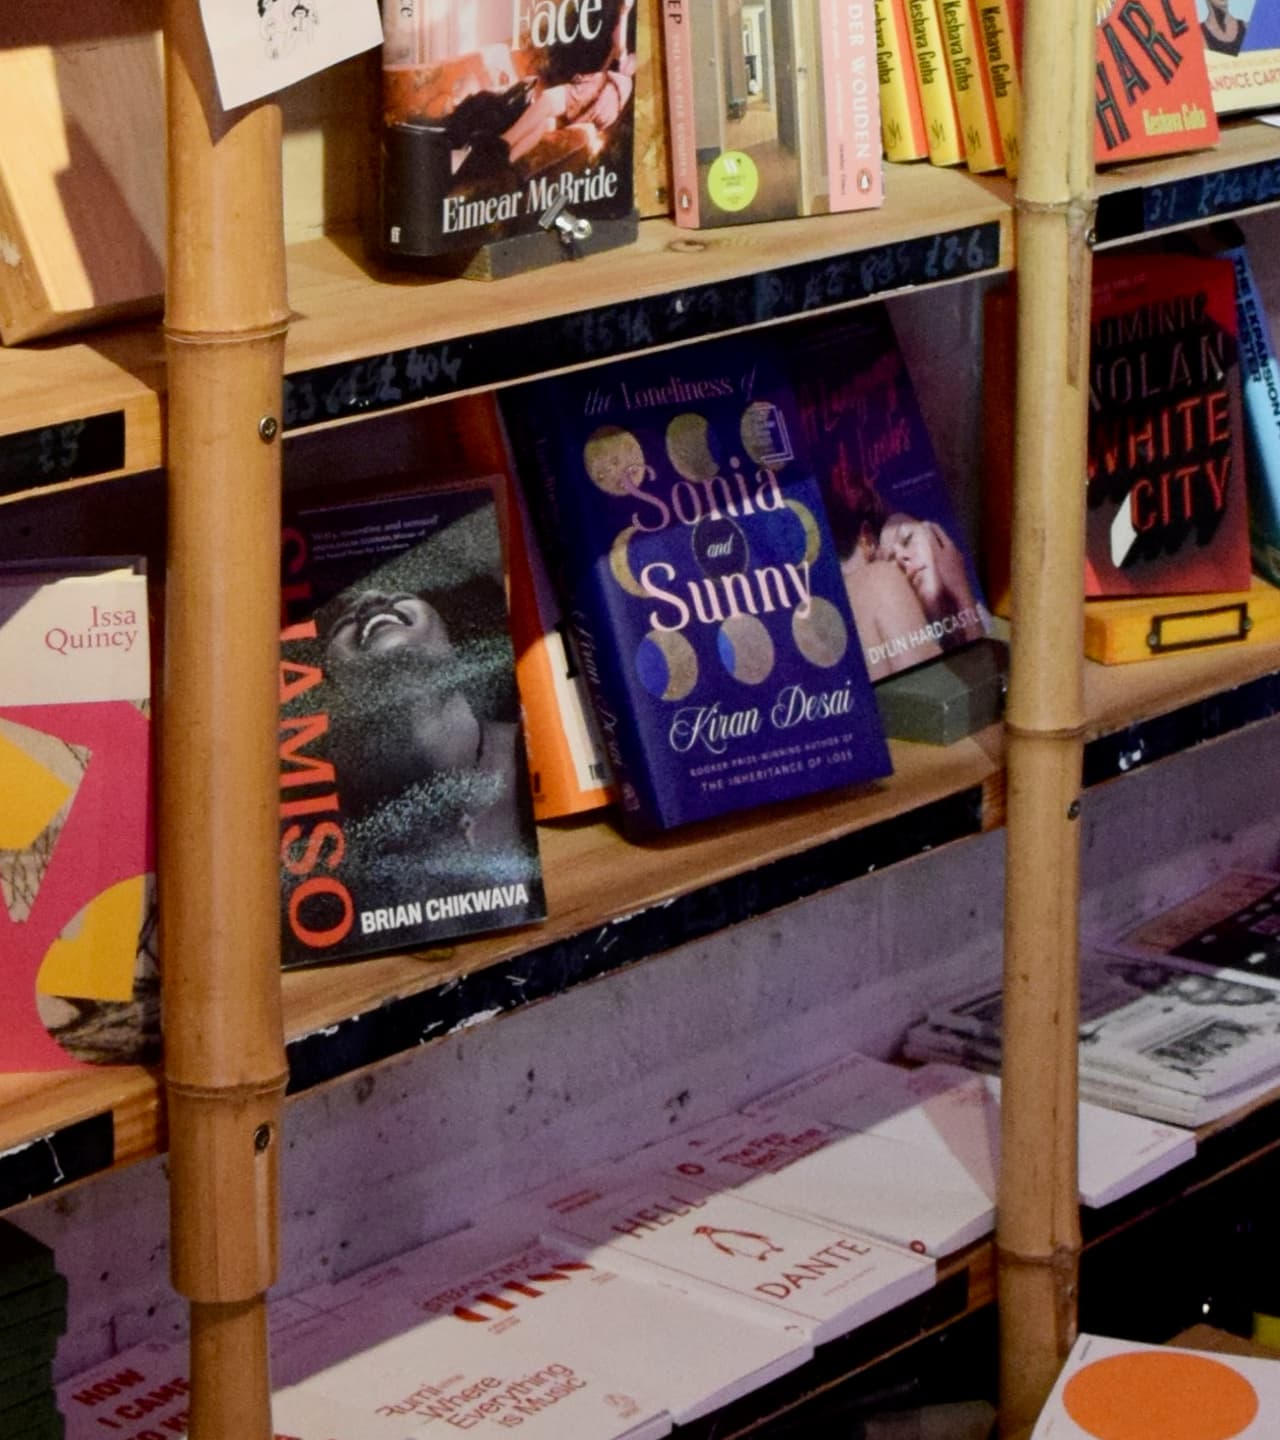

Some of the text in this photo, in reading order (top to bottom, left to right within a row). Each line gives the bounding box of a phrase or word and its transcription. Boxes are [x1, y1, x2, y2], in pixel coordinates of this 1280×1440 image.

[442, 187, 523, 236] Eimear
[631, 455, 785, 532] Sonia
[1132, 456, 1232, 533] CITY
[707, 534, 734, 559] and
[88, 603, 138, 630] Issa
[640, 560, 811, 634] Sunny
[44, 624, 139, 654] Quincy
[669, 680, 852, 754] Kiran Desai
[360, 882, 529, 935] BRIAN CHIKWAVA
[754, 1237, 872, 1301] DANTE
